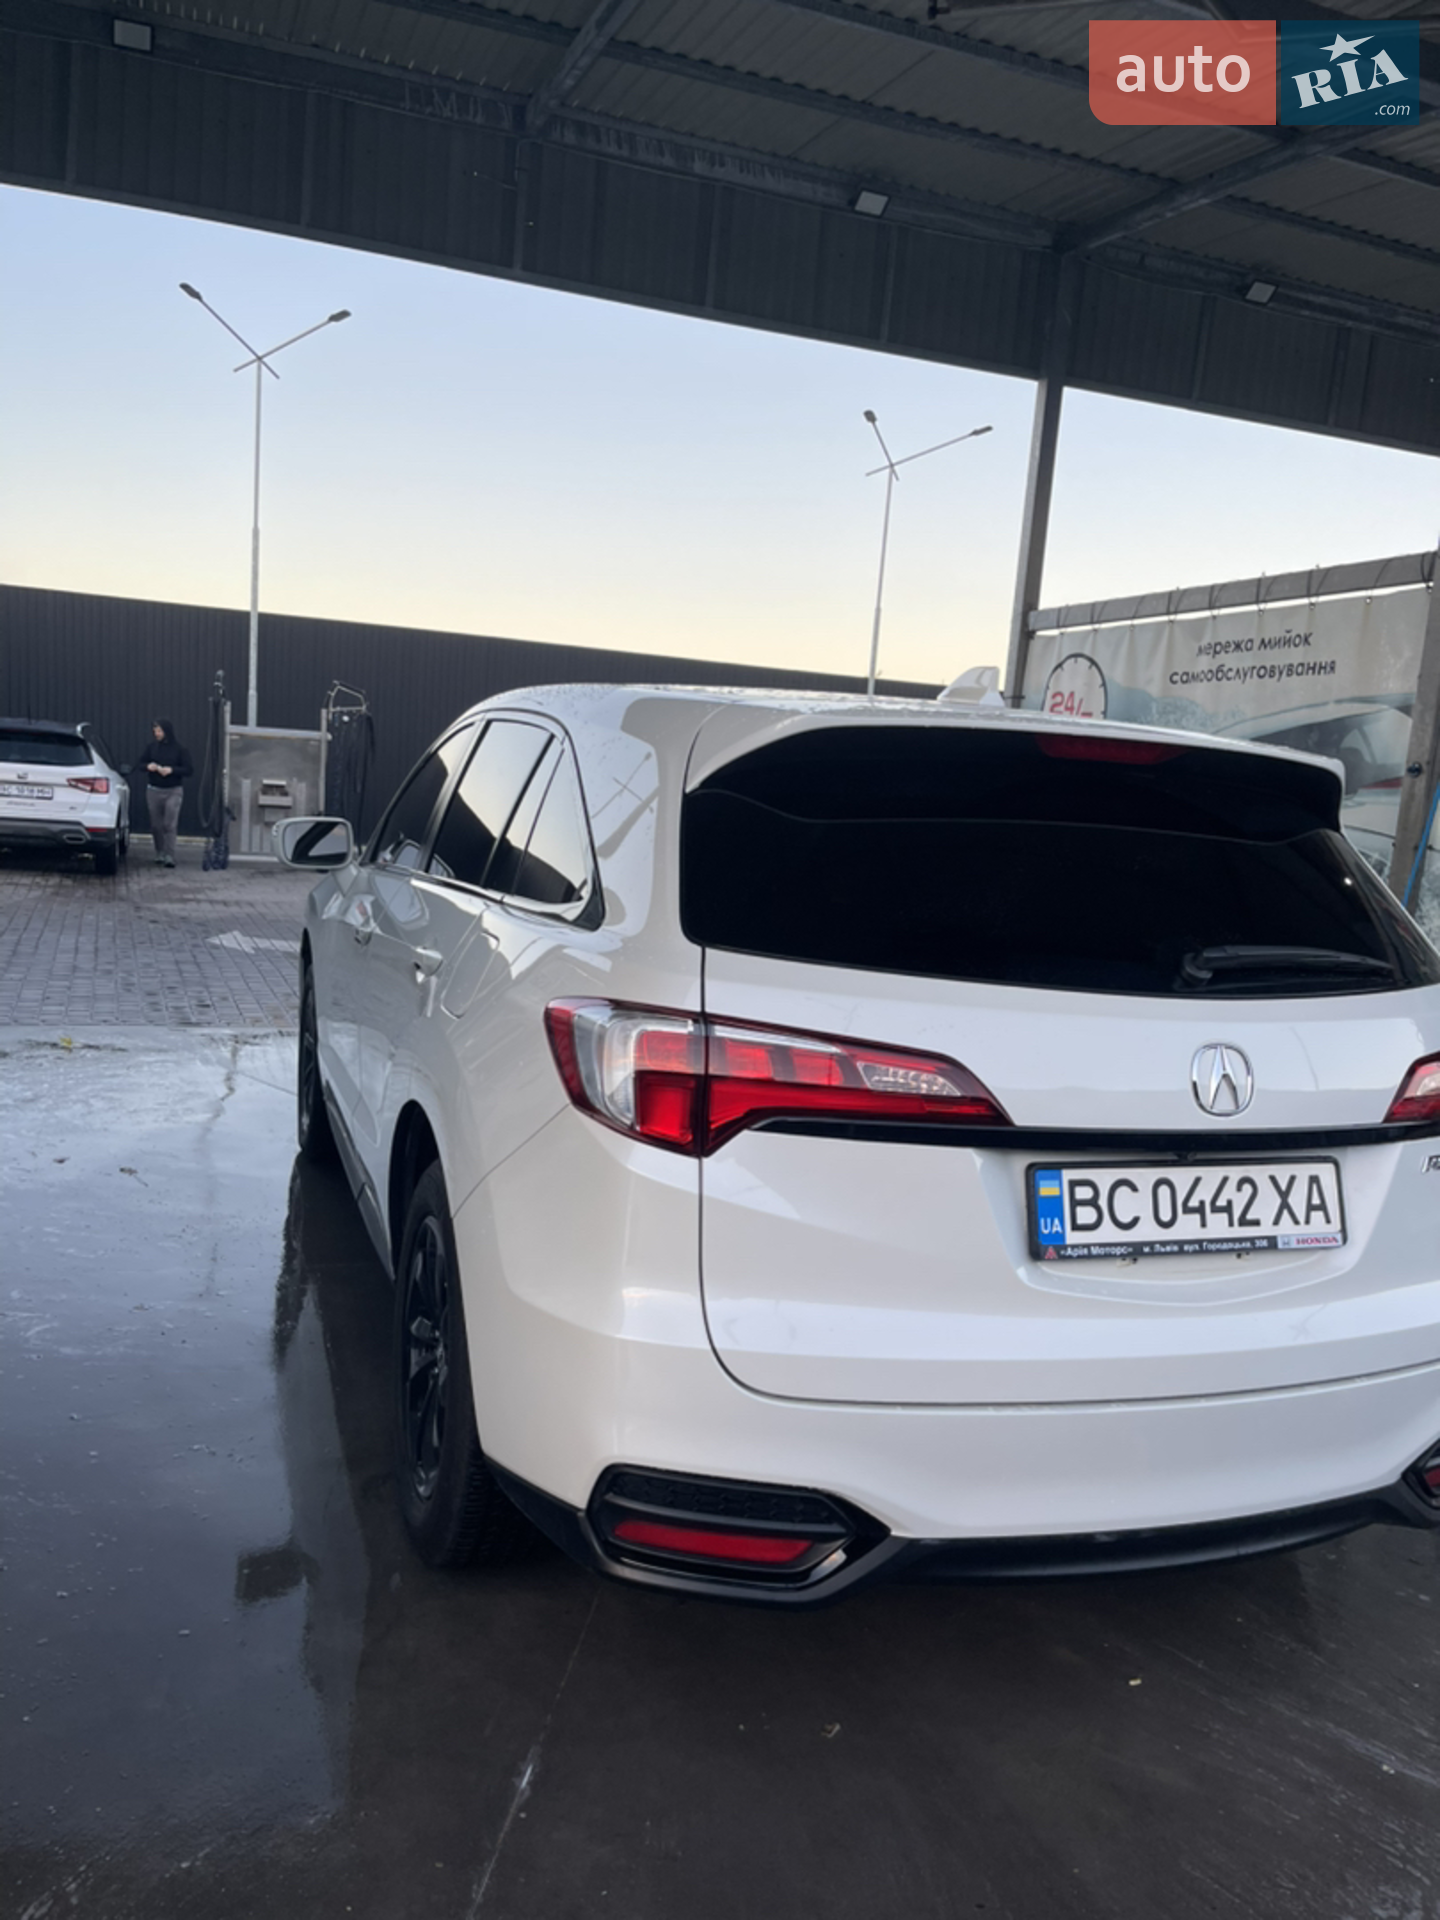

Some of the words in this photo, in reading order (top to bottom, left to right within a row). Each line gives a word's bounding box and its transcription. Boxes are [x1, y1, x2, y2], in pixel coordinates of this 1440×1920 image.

[1257, 629, 1314, 652] мийок
[1168, 659, 1337, 685] самообслуговування
[1040, 1217, 1063, 1235] UA
[1294, 1236, 1339, 1246] HONDA
